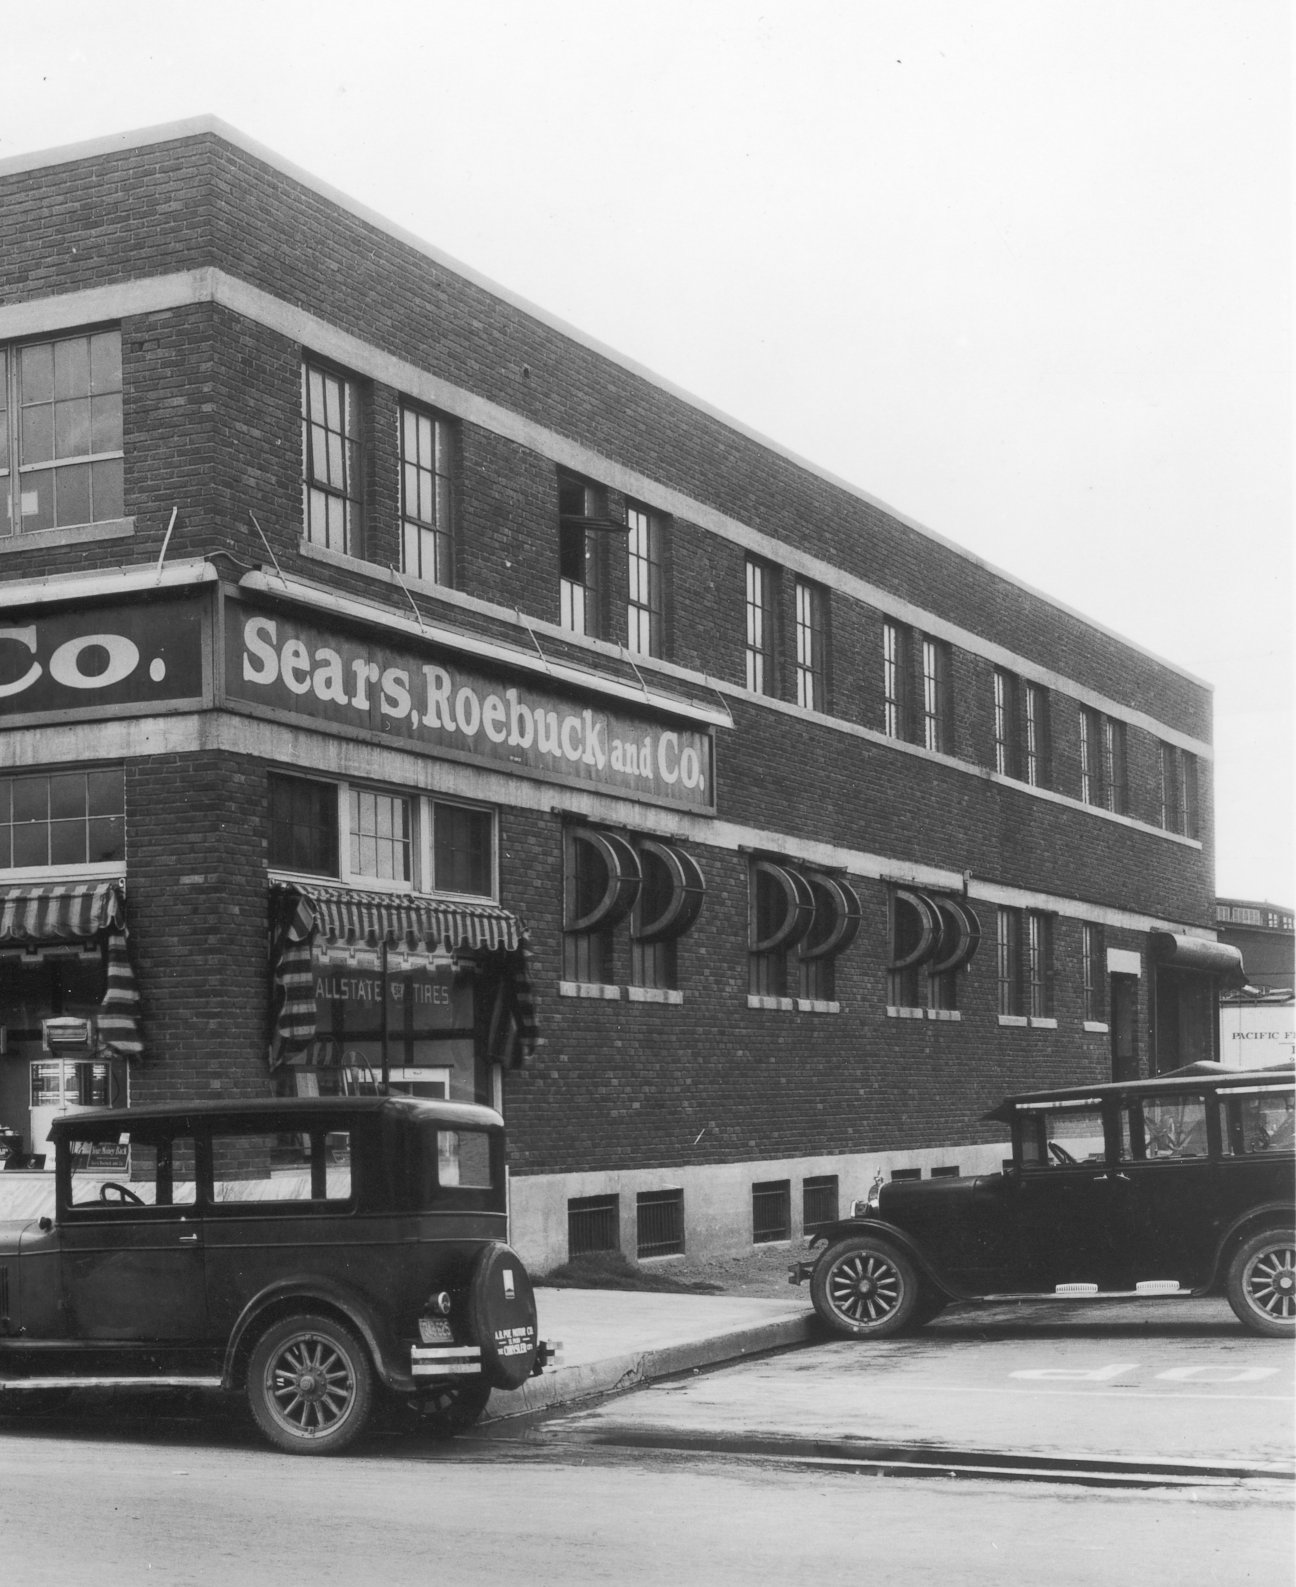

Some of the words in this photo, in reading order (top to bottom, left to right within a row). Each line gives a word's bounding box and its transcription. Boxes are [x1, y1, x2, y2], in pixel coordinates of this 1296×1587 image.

[243, 616, 420, 730] Sears,
[422, 664, 605, 771] Roebuck
[610, 737, 653, 779] and
[657, 730, 704, 792] Co.
[315, 978, 383, 1002] ALLSTATE
[413, 983, 449, 1005] TIRES
[1231, 1031, 1280, 1040] PACIFIC
